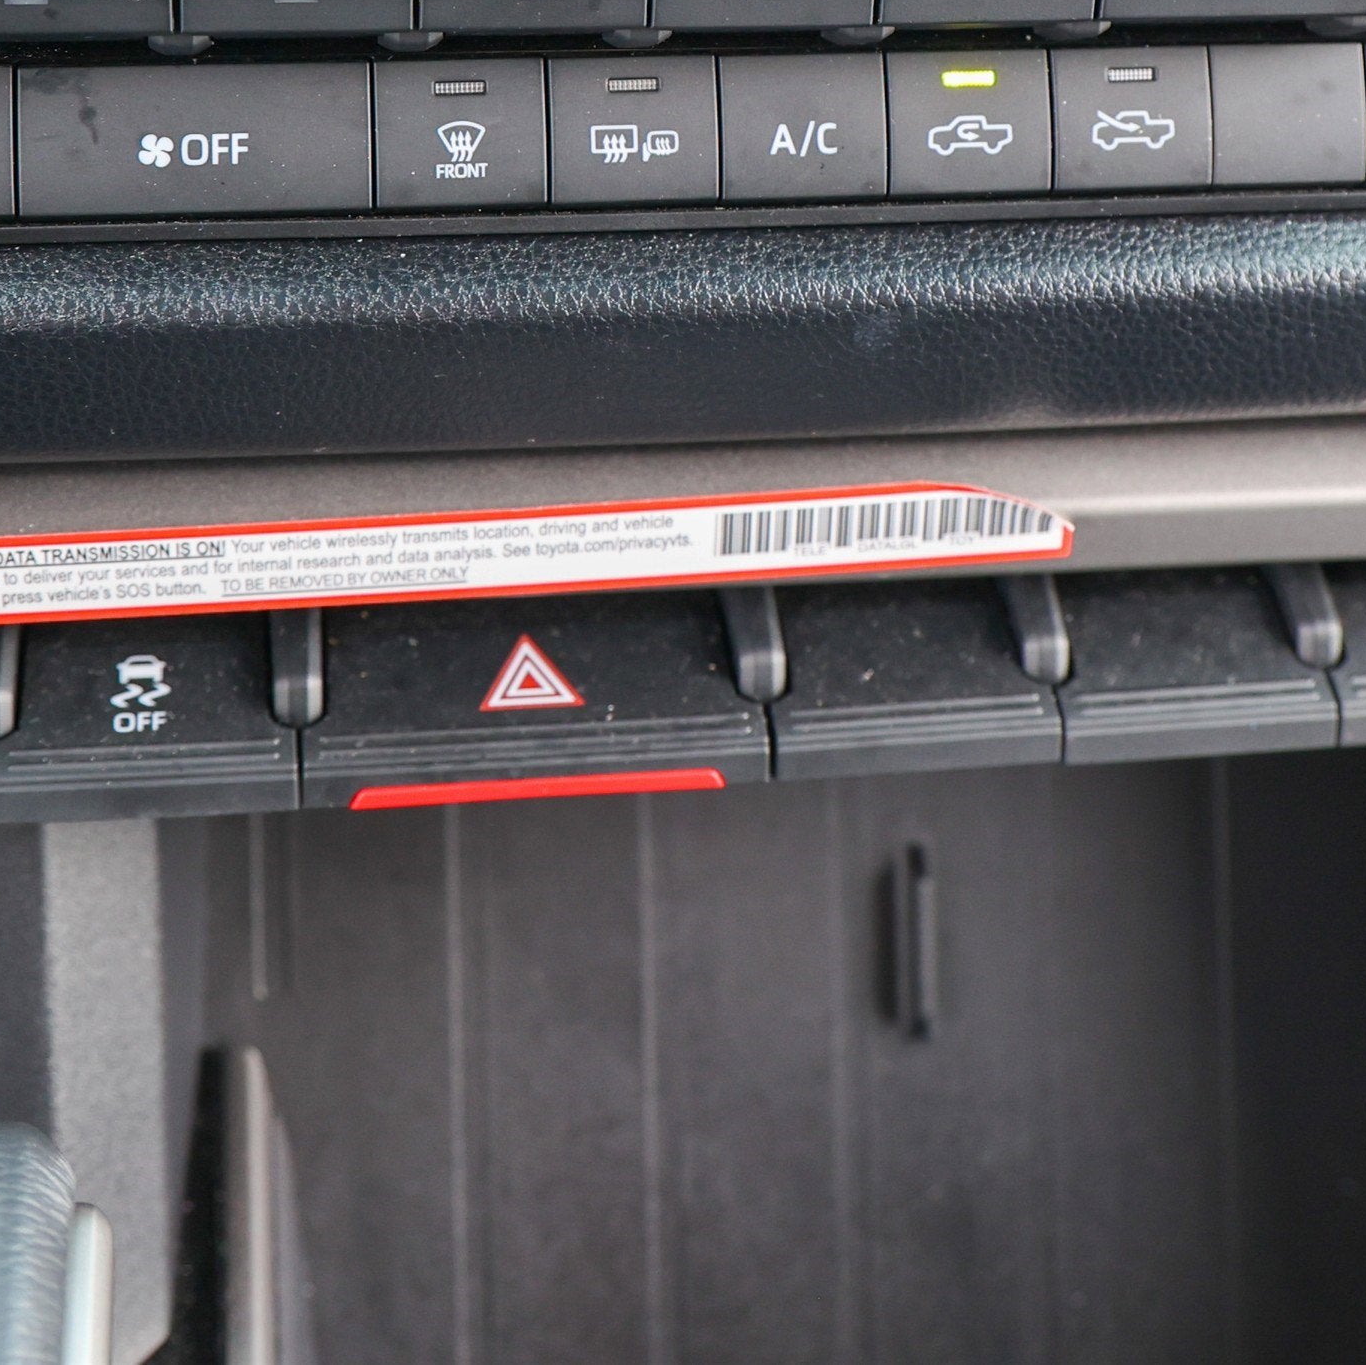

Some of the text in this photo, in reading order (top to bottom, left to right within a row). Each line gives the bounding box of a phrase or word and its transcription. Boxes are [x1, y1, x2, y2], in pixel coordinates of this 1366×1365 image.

[181, 131, 250, 167] OFF
[770, 121, 838, 155] A/C
[436, 163, 488, 179] FRONT
[41, 543, 170, 563] TRANSMISSION
[176, 542, 191, 557] IS
[196, 540, 226, 556] ON!
[232, 539, 264, 554] Your
[269, 535, 321, 551] vehicle
[326, 531, 397, 549] wirelessly
[402, 527, 469, 544] transmits
[474, 524, 534, 540] location,
[539, 521, 586, 538] driving
[592, 518, 619, 533] and
[623, 515, 674, 531] vehicle
[4, 571, 19, 585] to
[24, 566, 72, 583] deliver
[77, 566, 111, 583] your
[116, 562, 176, 578] services
[181, 560, 209, 575] and
[214, 558, 232, 574] for
[238, 557, 292, 573] internal
[297, 552, 360, 570] research
[366, 550, 393, 566] and
[398, 548, 428, 564] data
[434, 544, 496, 563] analysis.
[503, 542, 531, 558] See
[1, 590, 43, 606] press
[47, 584, 111, 602] vehicle's
[117, 582, 150, 598] SOS
[155, 578, 206, 595] button.
[222, 579, 241, 594] TO
[245, 577, 264, 592] BE
[268, 572, 343, 590] REMOVED
[348, 571, 367, 585] BY
[371, 567, 427, 583] OWNER
[430, 565, 469, 581] ONLY
[112, 710, 167, 733] OFF
